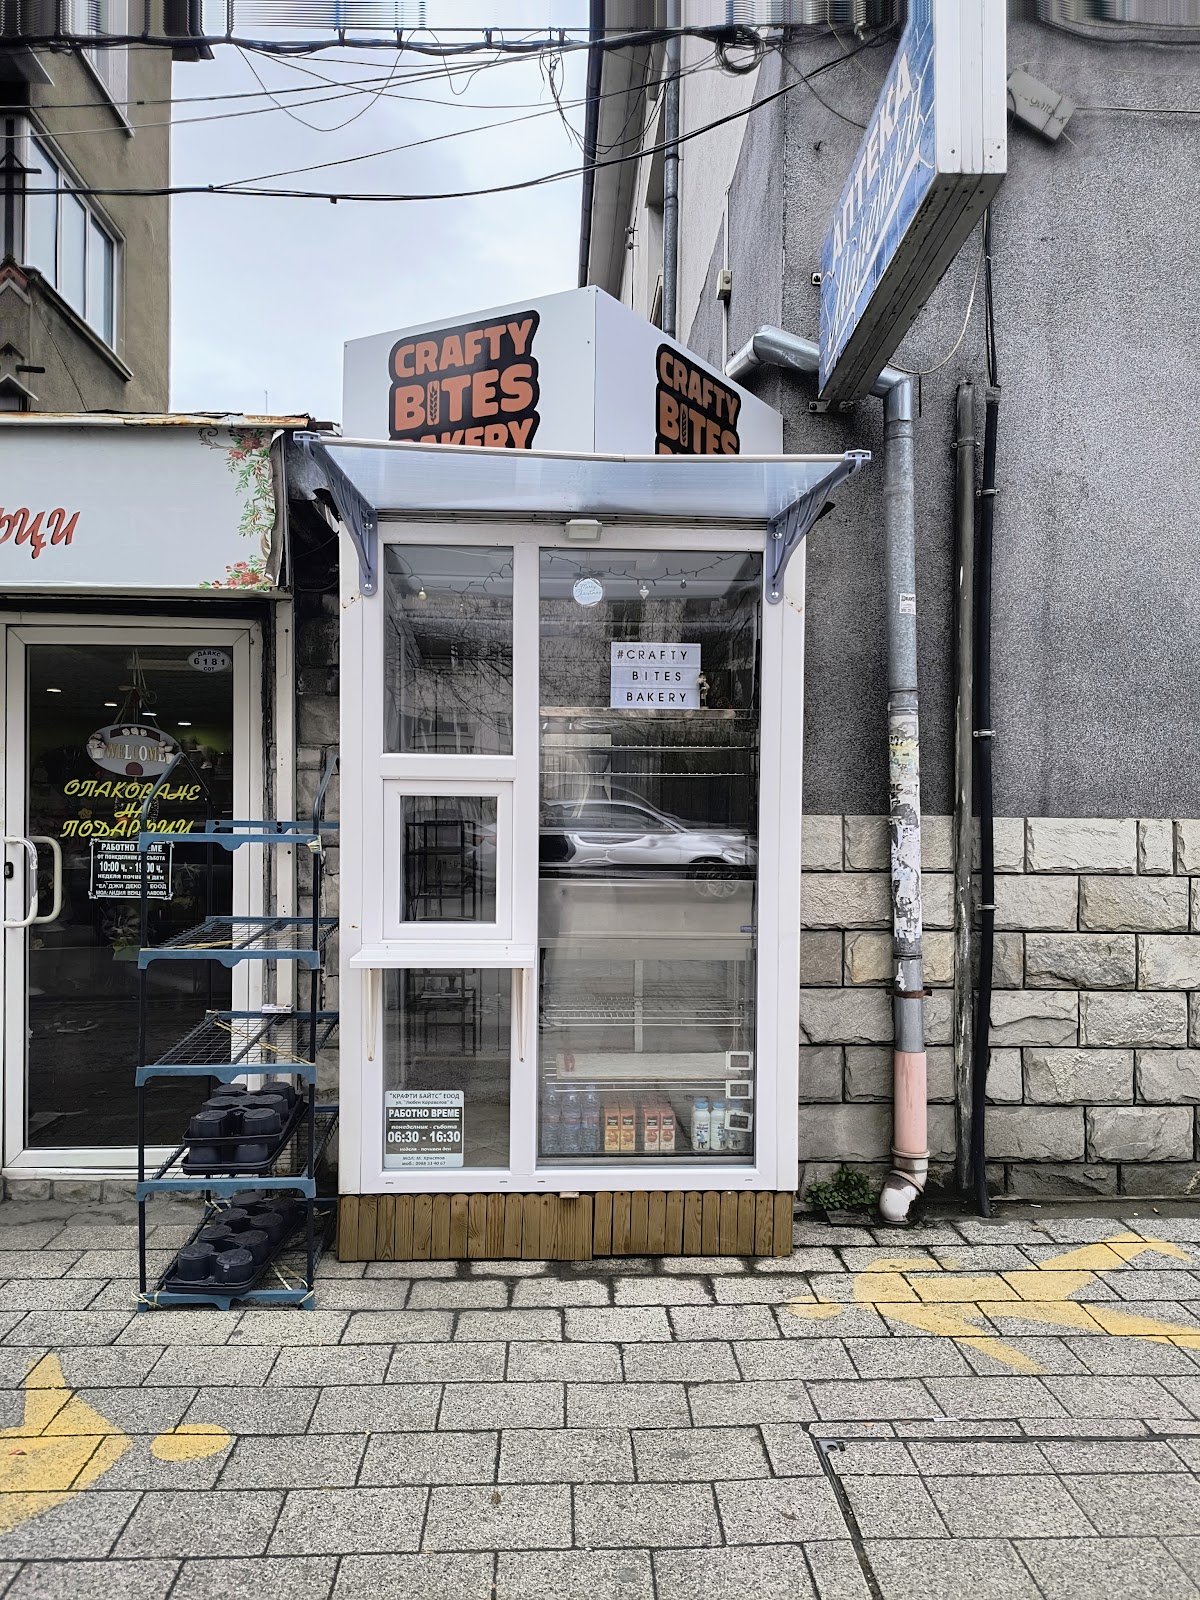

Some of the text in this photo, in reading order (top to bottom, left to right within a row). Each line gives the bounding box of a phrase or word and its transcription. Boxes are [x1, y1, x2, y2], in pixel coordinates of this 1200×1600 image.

[831, 52, 913, 270] АПТЕКА
[394, 318, 533, 378] CRAFTY
[659, 350, 738, 424] CRAFTY
[394, 364, 533, 431] BITES
[659, 390, 738, 454] BITES
[616, 649, 688, 661] #CRAFTY
[632, 671, 682, 682] BITES
[626, 692, 687, 703] BAKERY
[63, 779, 202, 801] ОПАКОВАНЕ
[101, 843, 135, 852] РАБОТНО
[99, 861, 120, 872] 10:00
[389, 1109, 460, 1117] РАБОТНО ВРЕМЕ
[388, 1131, 419, 1142] 06:30
[430, 1131, 460, 1142] 16:30
